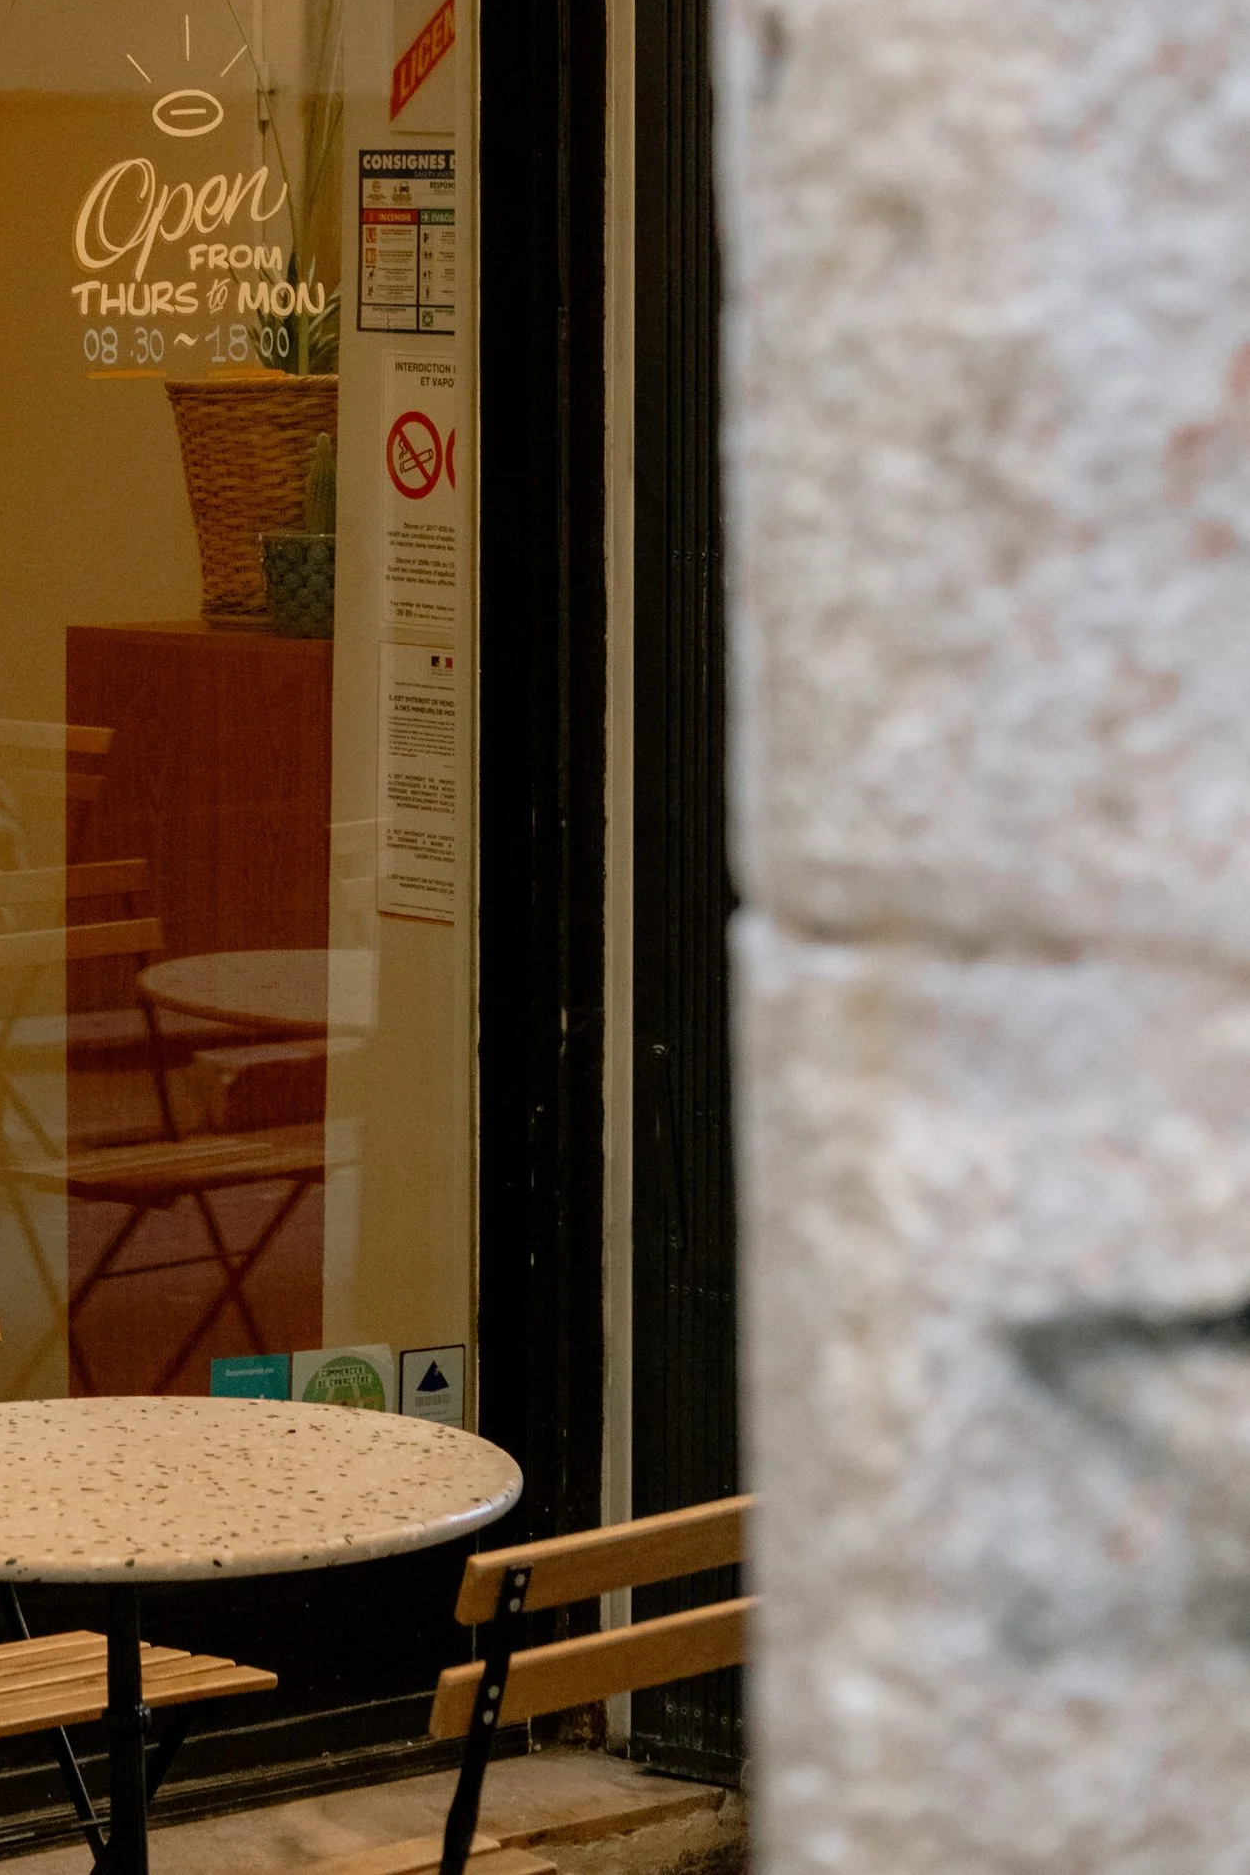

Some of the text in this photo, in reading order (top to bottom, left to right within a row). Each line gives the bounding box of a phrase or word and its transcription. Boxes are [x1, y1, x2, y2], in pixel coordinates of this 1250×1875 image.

[362, 154, 446, 170] CONSIGNES
[75, 157, 289, 283] Open
[378, 212, 412, 223] INCENDIE
[188, 243, 283, 271] FROM
[71, 278, 326, 317] THURS to MON
[395, 361, 452, 374] INTERDICTION
[420, 377, 431, 386] ET
